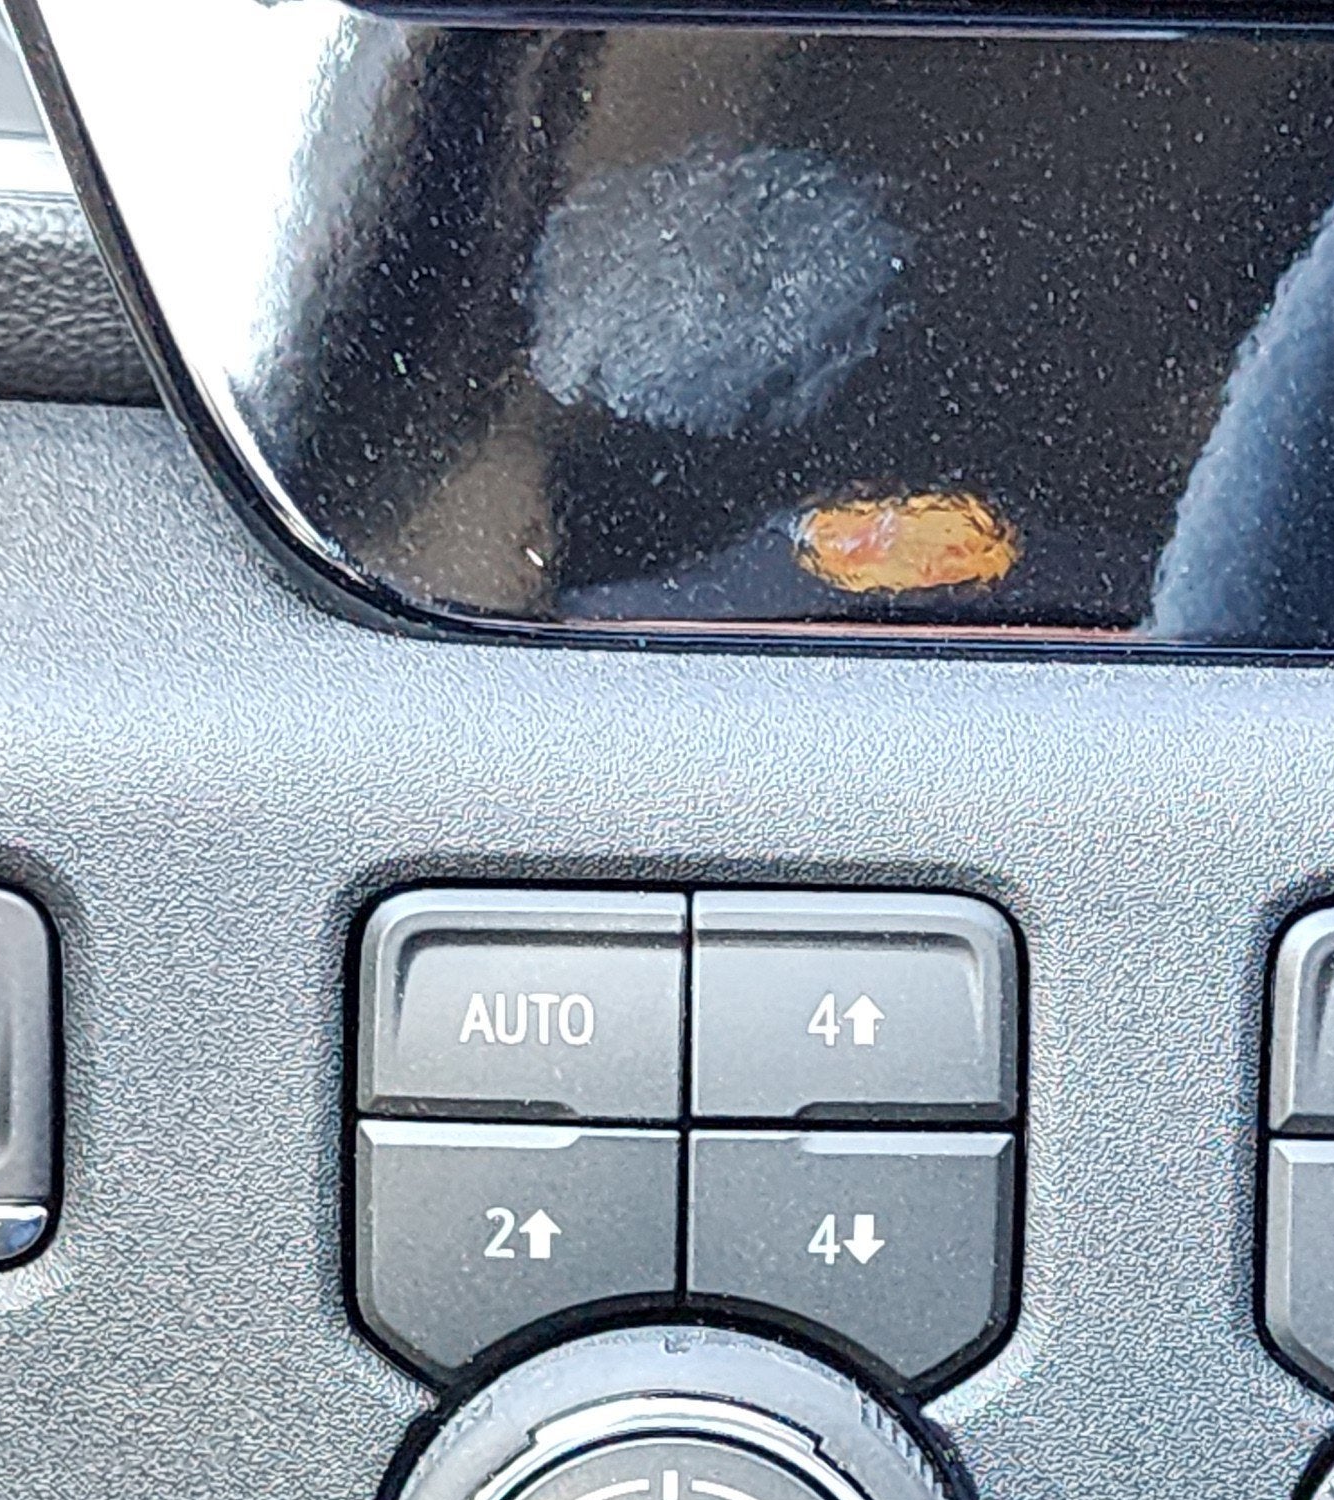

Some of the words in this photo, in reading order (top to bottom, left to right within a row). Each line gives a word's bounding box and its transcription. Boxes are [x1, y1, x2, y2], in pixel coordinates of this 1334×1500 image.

[459, 992, 594, 1045] AUTO
[807, 993, 840, 1046] 4
[483, 1207, 515, 1259] 2
[807, 1214, 841, 1265] 4
